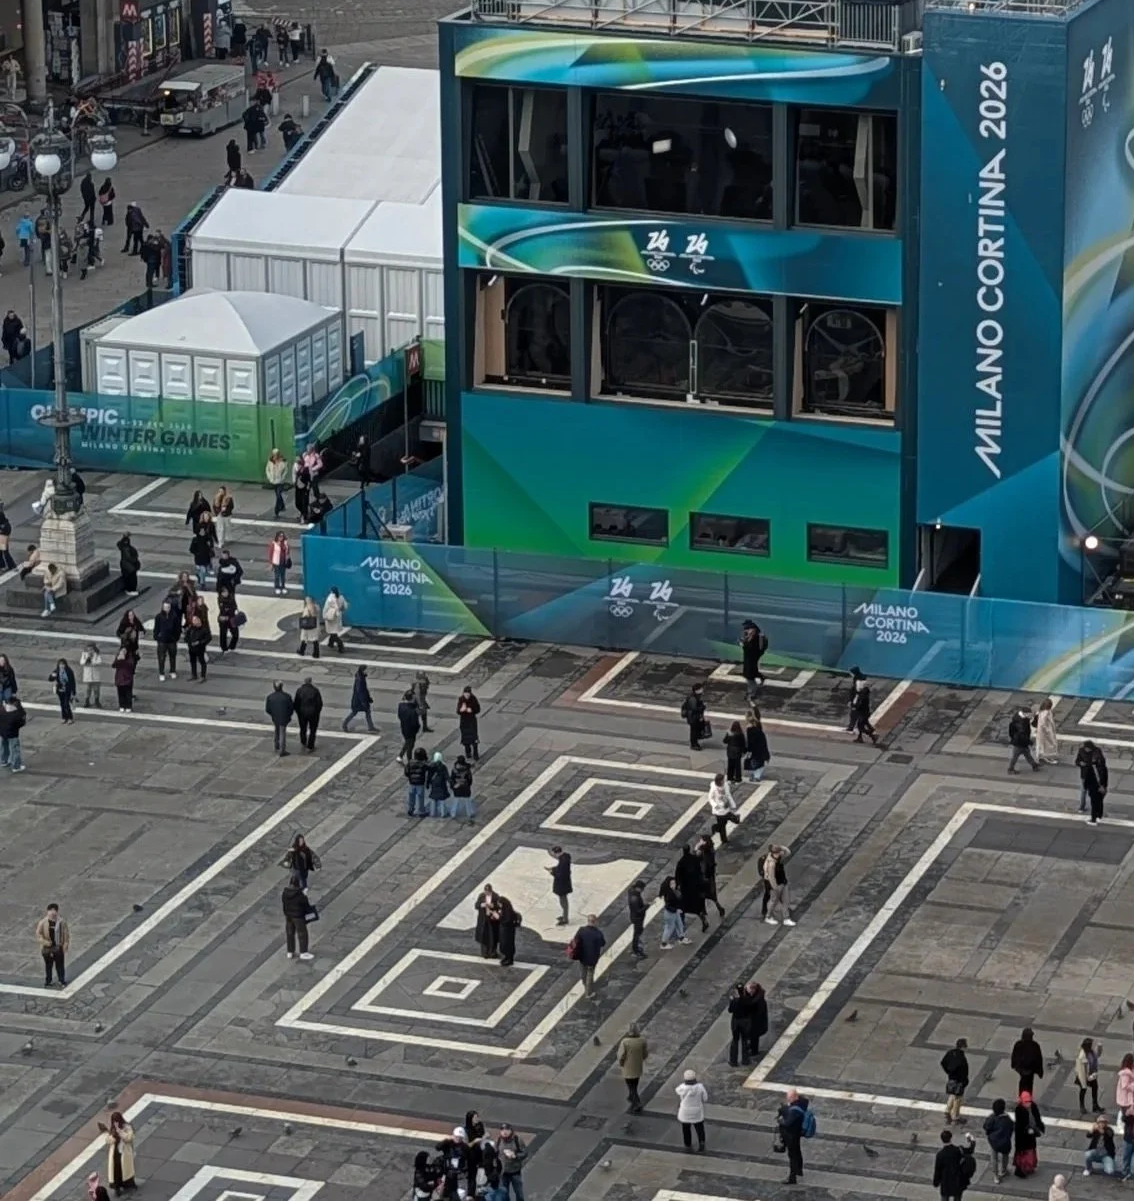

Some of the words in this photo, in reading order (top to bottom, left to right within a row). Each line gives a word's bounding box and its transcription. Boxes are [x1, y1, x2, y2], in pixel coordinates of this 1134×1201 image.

[122, 3, 138, 17] M
[978, 61, 1007, 140] 2026
[976, 148, 1006, 312] CORTINA
[974, 318, 1004, 480] MILANO
[81, 426, 156, 445] WINTER
[160, 430, 231, 450] GAMES
[360, 556, 421, 571] MILANO
[371, 569, 434, 585] CORTINA
[383, 583, 413, 596] 2026
[853, 602, 918, 619] MILANO
[864, 616, 930, 634] CORTINA
[876, 630, 907, 644] 2026
